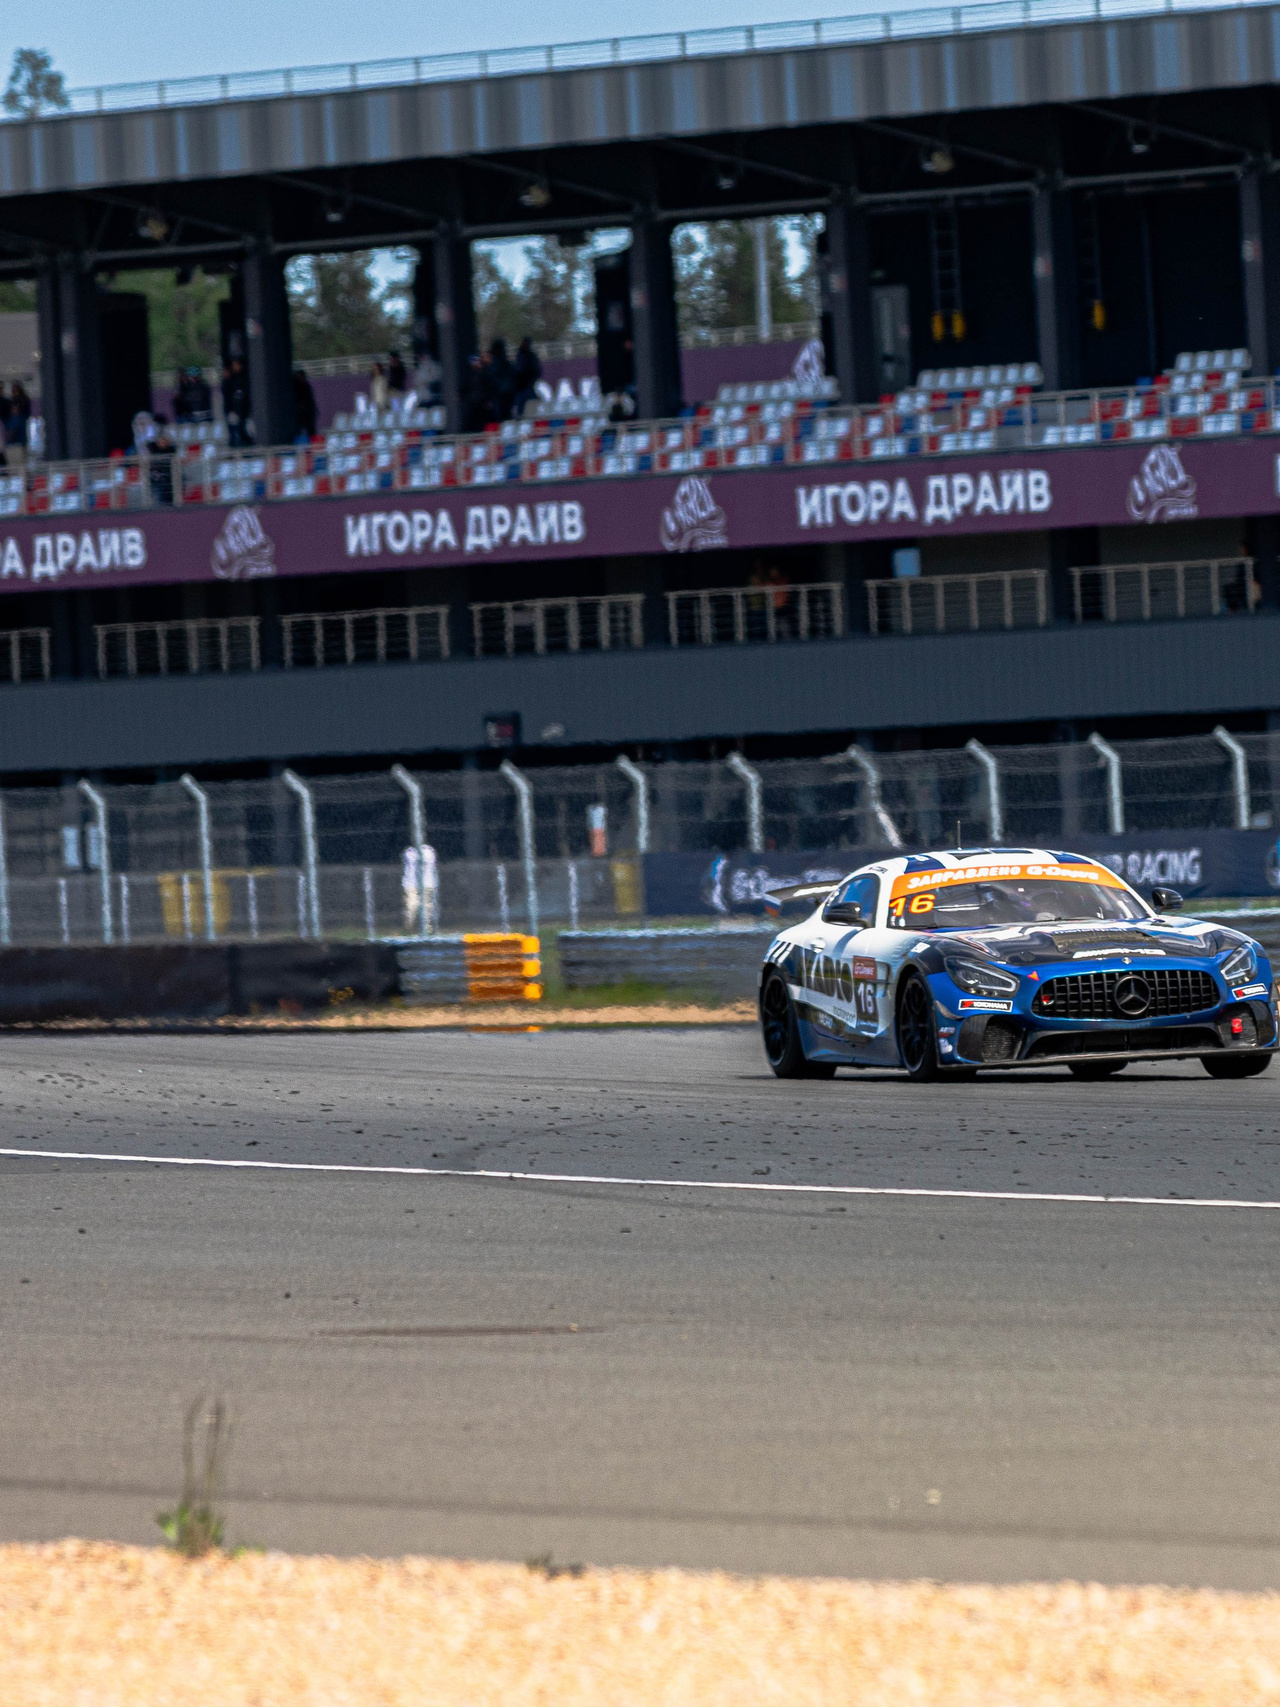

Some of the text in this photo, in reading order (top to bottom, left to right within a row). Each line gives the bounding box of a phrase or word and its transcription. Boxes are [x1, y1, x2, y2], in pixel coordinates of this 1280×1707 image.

[797, 470, 1052, 527] ИГОРА ДРАЙВ
[346, 502, 585, 556] ИГОРА ДРАЙВ
[31, 527, 146, 581] ДРАЙВ
[907, 866, 1021, 889] ЗАПРАВЛЕНО
[889, 893, 936, 917] 16
[857, 981, 874, 1015] 16
